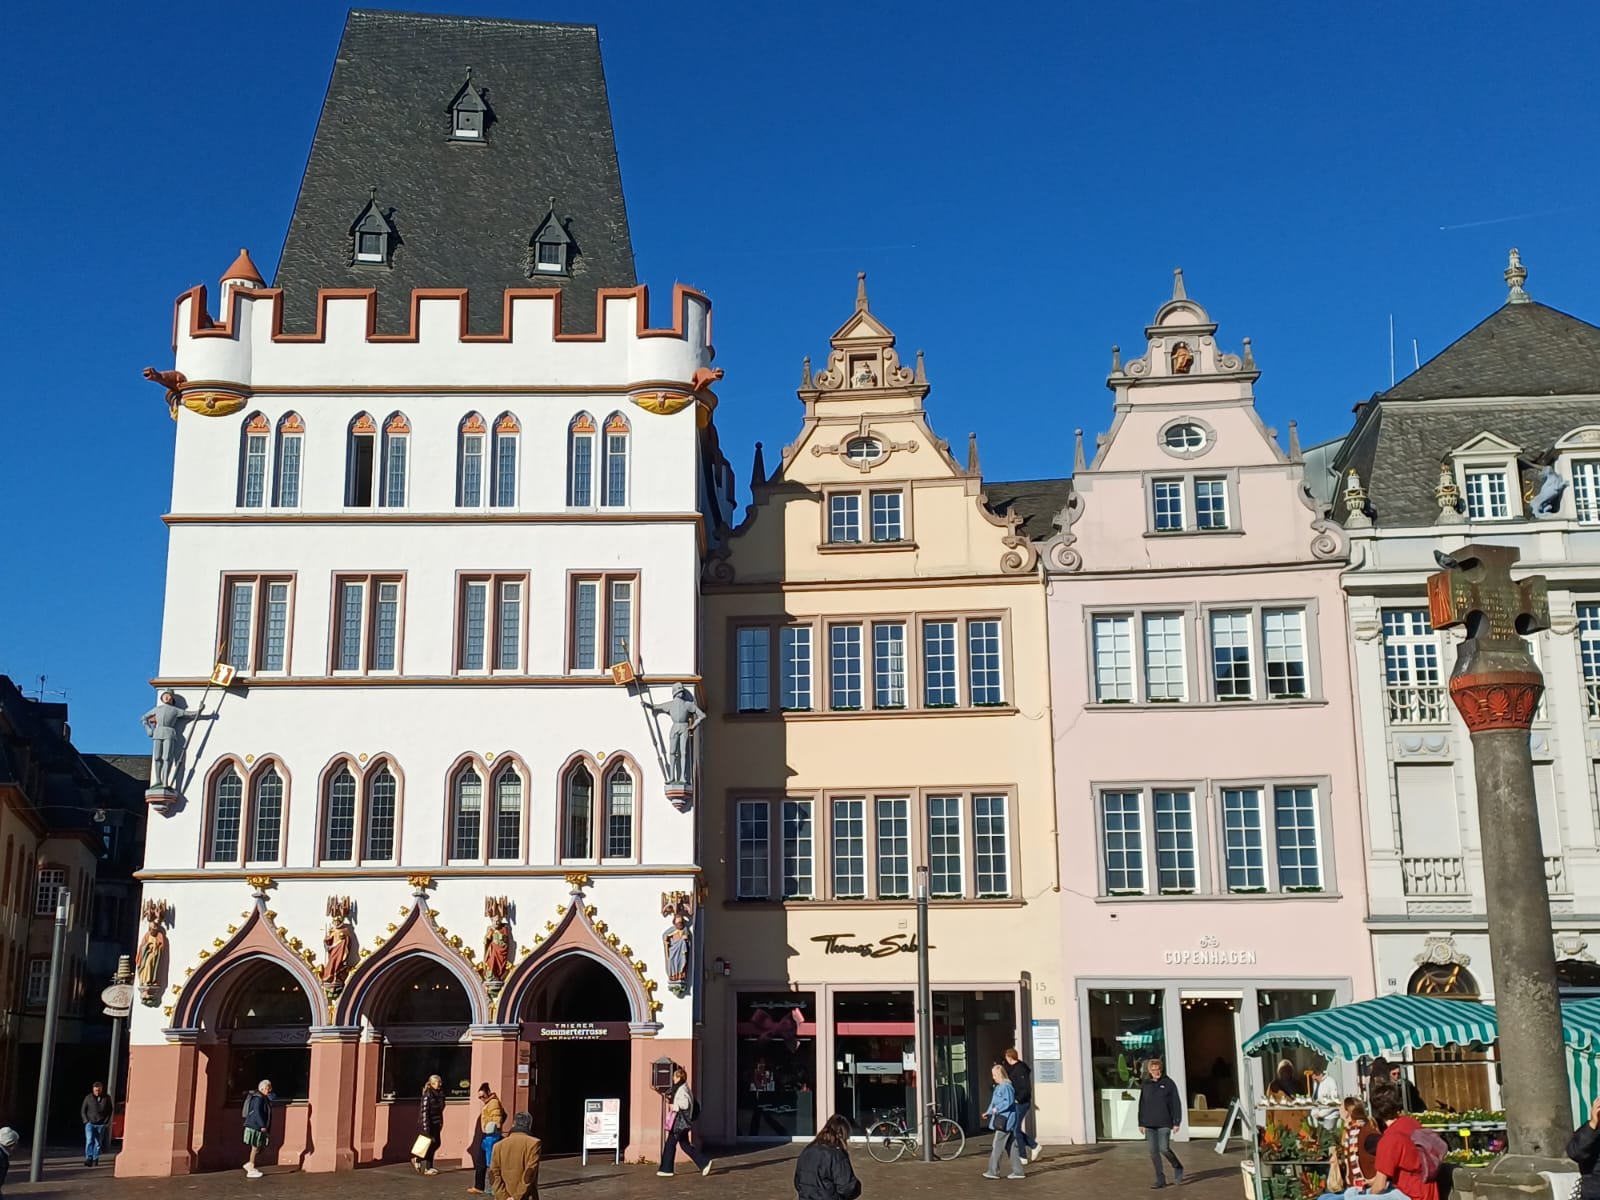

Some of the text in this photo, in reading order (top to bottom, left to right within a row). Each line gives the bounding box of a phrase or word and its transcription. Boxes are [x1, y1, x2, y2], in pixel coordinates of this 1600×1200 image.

[810, 933, 936, 958] Thomas Sab
[1164, 951, 1257, 965] COPENHAGEN
[1035, 982, 1047, 991] 15
[1043, 996, 1056, 1006] 16
[541, 1028, 608, 1036] Sommerterrasse
